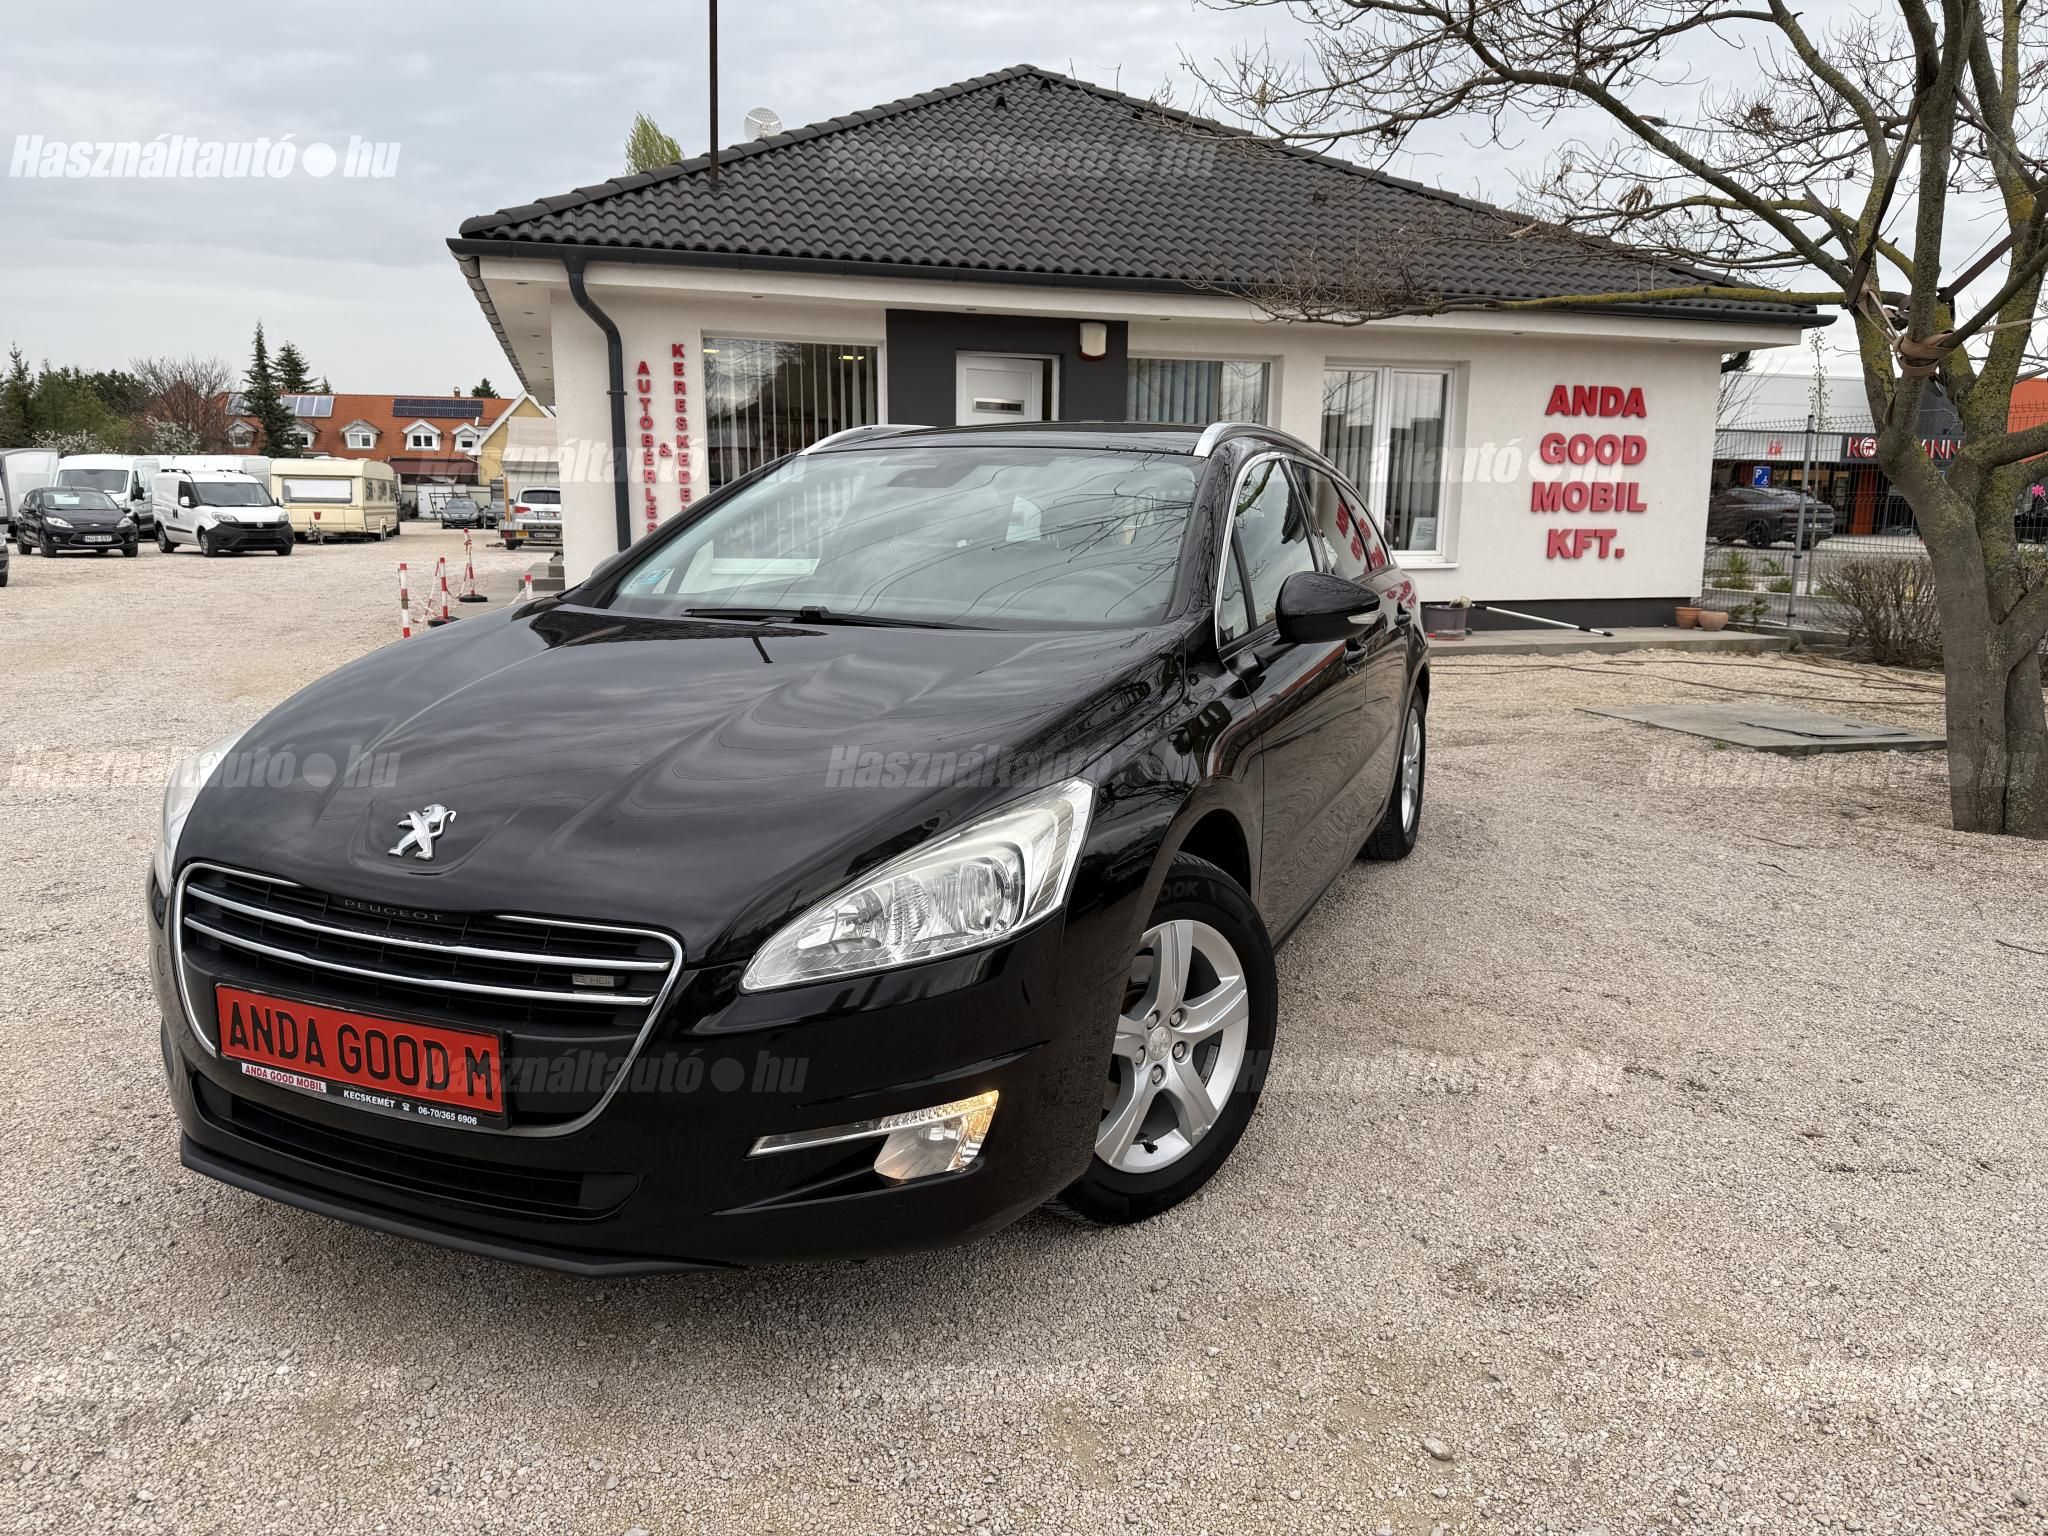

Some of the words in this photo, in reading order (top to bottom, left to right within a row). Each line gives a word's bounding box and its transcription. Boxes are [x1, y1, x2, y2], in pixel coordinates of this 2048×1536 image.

[1545, 385, 1647, 418] ANDA
[672, 344, 691, 511] KERESKEDE
[659, 442, 672, 457] &
[1540, 433, 1647, 465] GOOD
[1755, 469, 1762, 478] P
[1531, 482, 1647, 512] MOBIL
[1547, 528, 1625, 559] KFT.
[344, 899, 443, 921] PEUGEOT
[229, 1000, 325, 1067] ANDA
[337, 1024, 450, 1092] GOOD
[465, 1046, 493, 1099] M
[245, 1065, 268, 1079] ANDA
[270, 1071, 294, 1084] GOOD
[296, 1076, 325, 1092] MOBIL
[343, 1090, 396, 1108] KECSKEMÉT
[418, 1106, 456, 1122] 06-70/365
[458, 1113, 477, 1125] 6906
